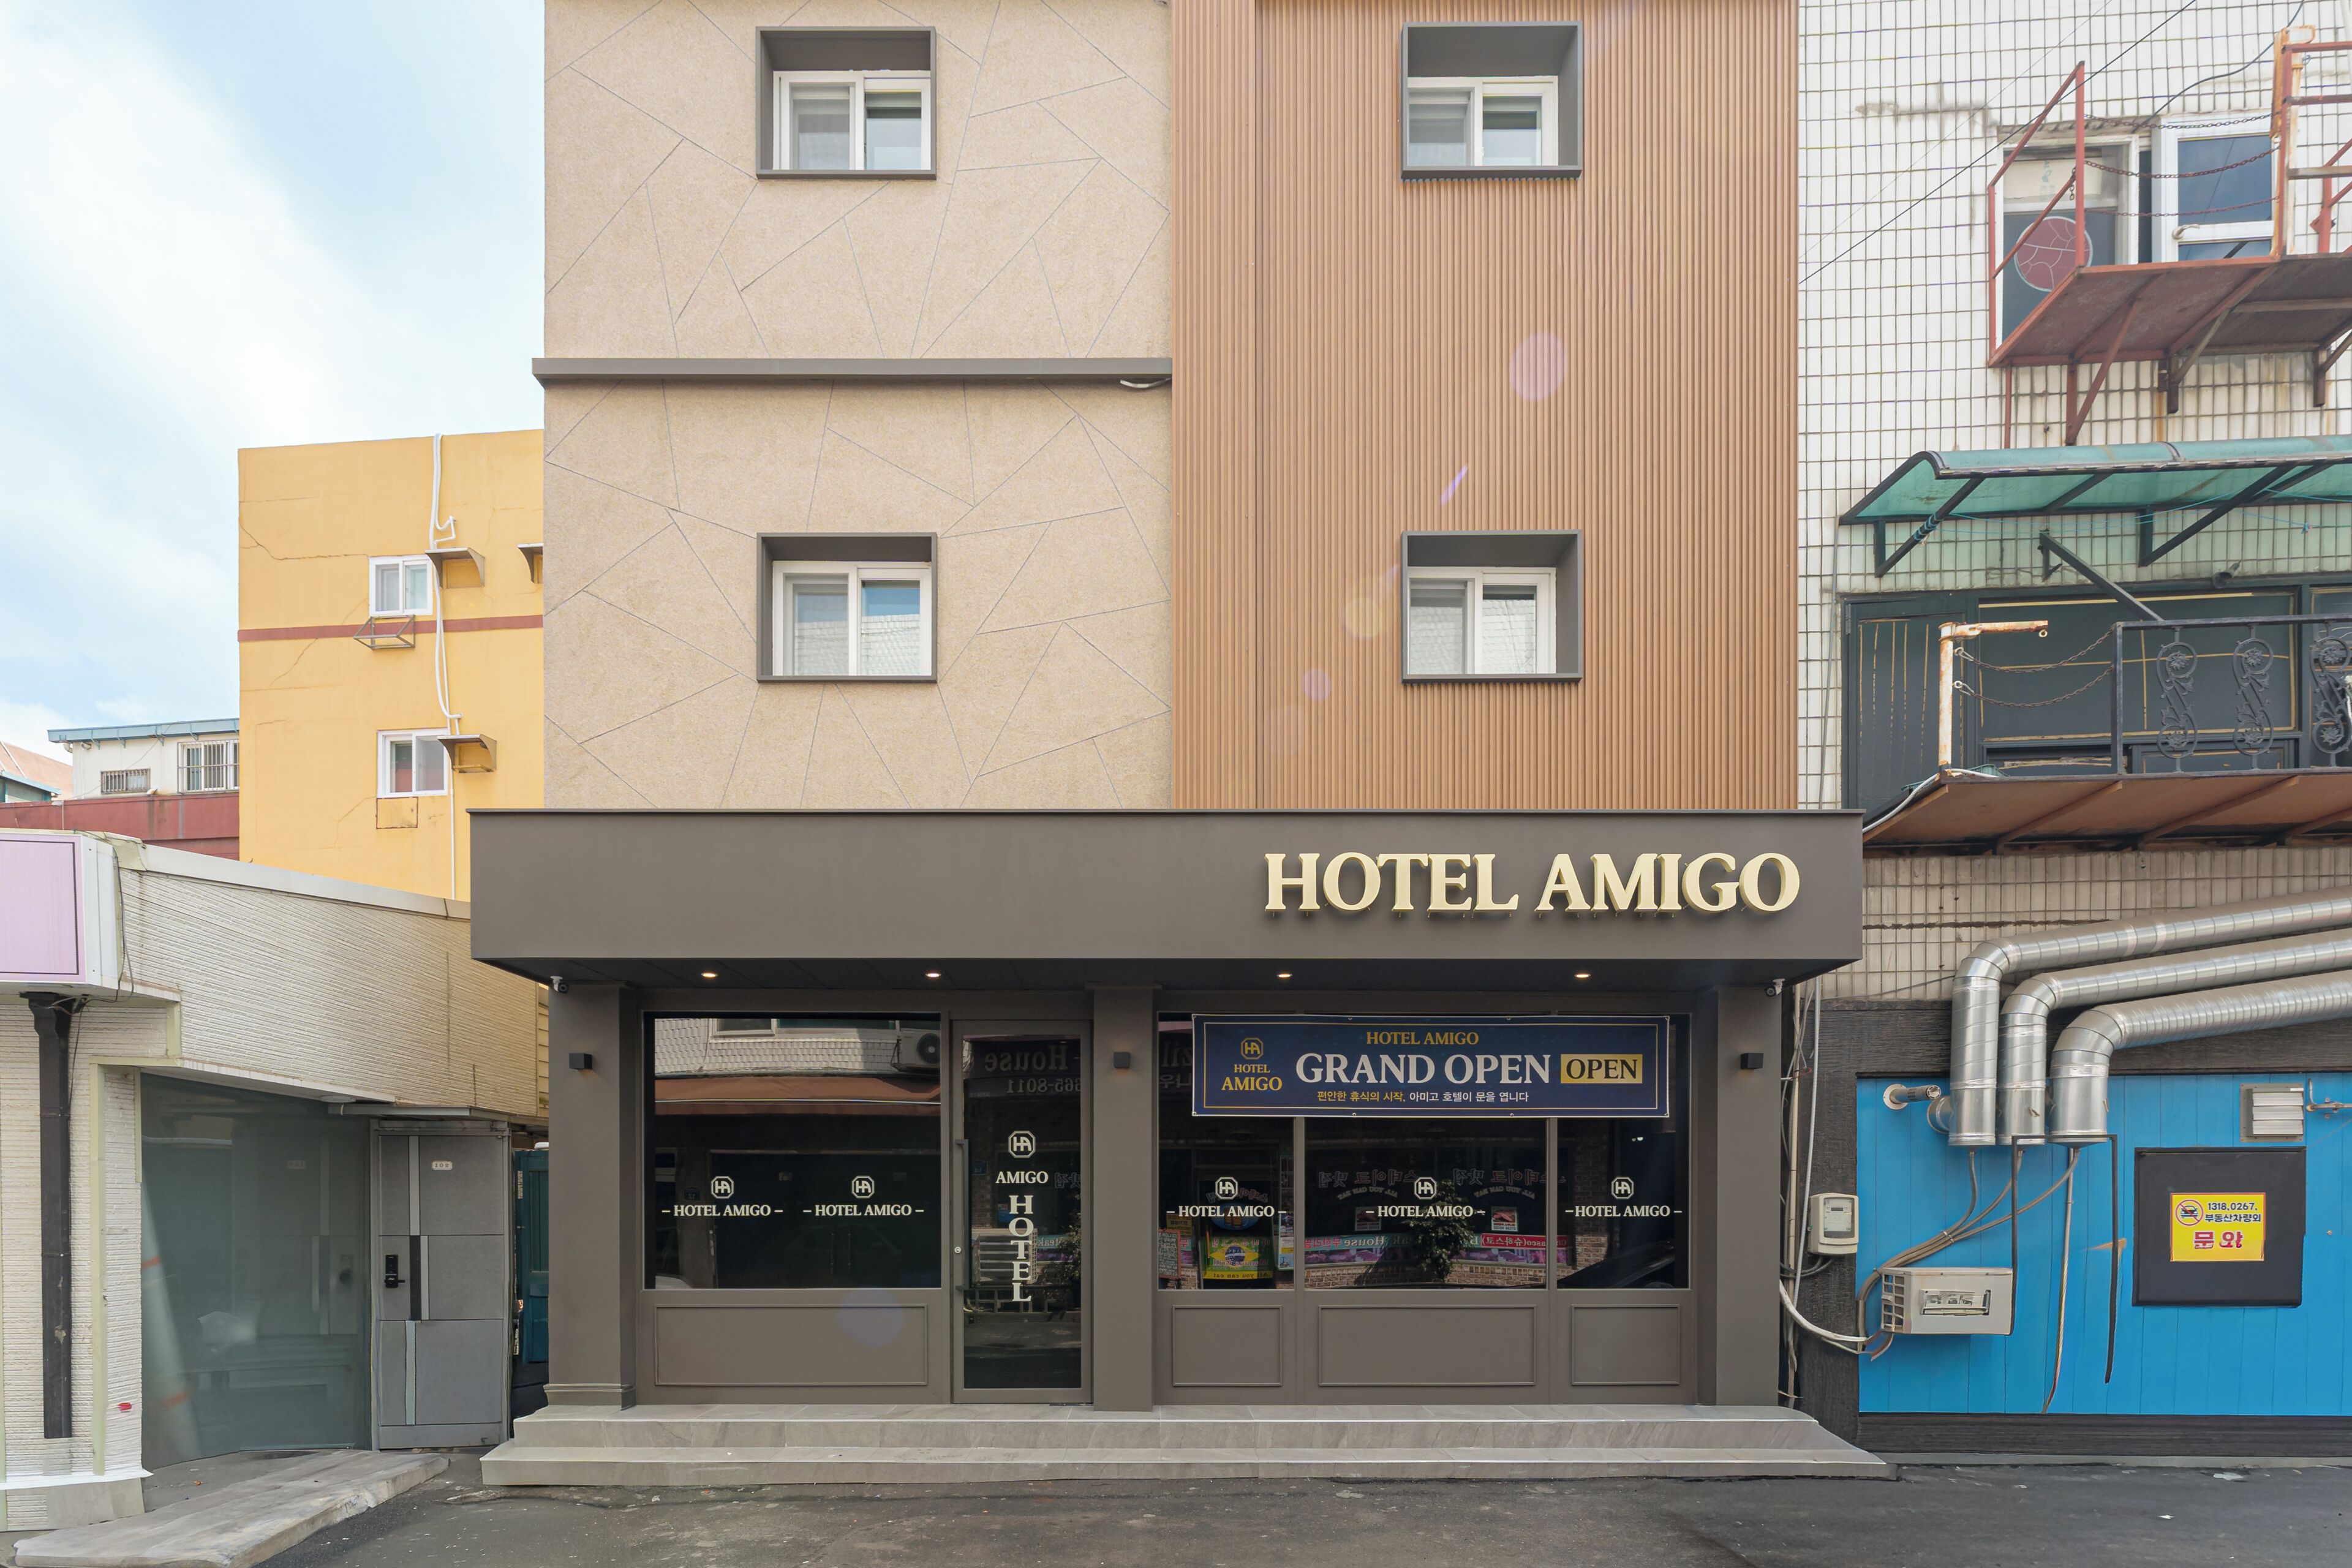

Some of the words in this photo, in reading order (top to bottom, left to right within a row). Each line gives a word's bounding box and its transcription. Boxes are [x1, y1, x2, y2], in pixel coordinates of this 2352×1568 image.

[1264, 852, 1519, 911] HOTEL
[1534, 852, 1800, 911] AMIGO
[1366, 1032, 1420, 1045] HOTEL
[1423, 1032, 1479, 1045] AMIGO
[1234, 1064, 1270, 1074] HOTEL
[1296, 1053, 1435, 1084] GRAND
[1444, 1055, 1551, 1084] OPEN
[1566, 1059, 1637, 1080] OPEN
[1221, 1077, 1283, 1091] AMIGO
[1317, 1091, 1347, 1102] 편안한
[1350, 1091, 1379, 1102] 휴식의
[1383, 1091, 1406, 1102] 시작,
[1409, 1092, 1439, 1102] 아미고
[1442, 1092, 1472, 1102] 호텔이
[1476, 1092, 1496, 1102] 문을
[1499, 1092, 1529, 1102] 엽니다
[995, 1170, 1049, 1185] AMIGO
[674, 1205, 720, 1216] HOTEL
[723, 1205, 771, 1216] AMIGO
[815, 1205, 861, 1216] HOTEL
[864, 1205, 912, 1216] AMIGO
[1178, 1206, 1224, 1218] HOTEL
[1227, 1205, 1275, 1218] AMIGO
[1378, 1206, 1423, 1218] HOTEL
[1426, 1206, 1474, 1218] AMIGO
[1575, 1206, 1621, 1218] HOTEL
[1623, 1205, 1671, 1218] AMIGO
[2205, 1214, 2261, 1223] 부동산차량외
[1009, 1196, 1034, 1302] HOTEL
